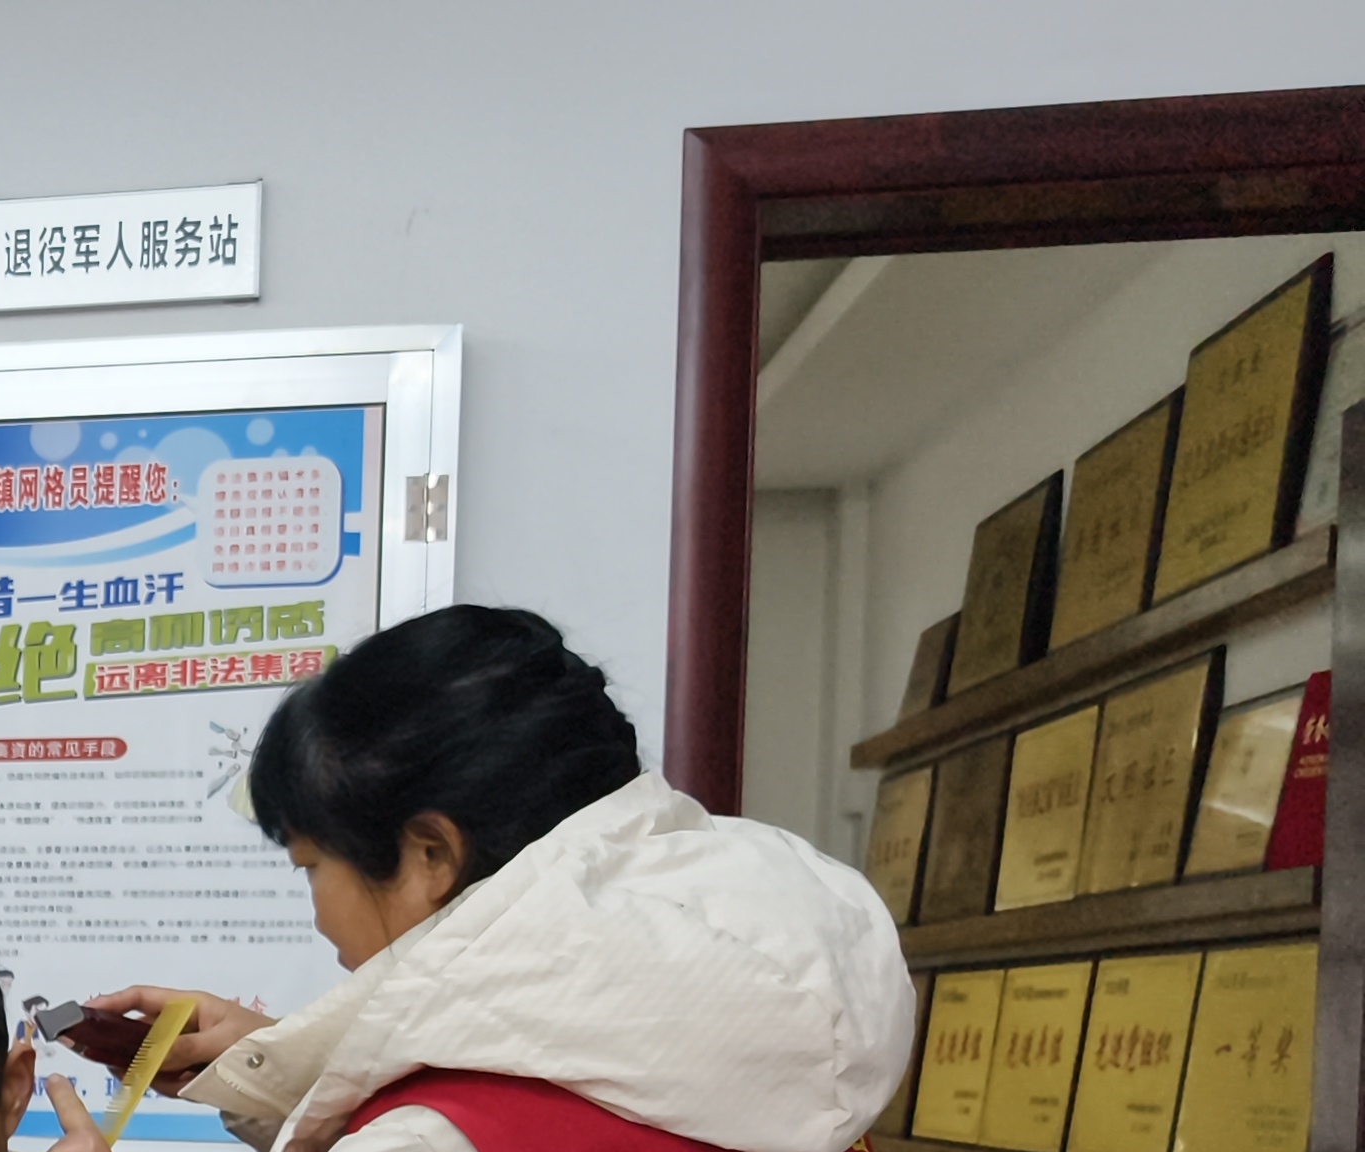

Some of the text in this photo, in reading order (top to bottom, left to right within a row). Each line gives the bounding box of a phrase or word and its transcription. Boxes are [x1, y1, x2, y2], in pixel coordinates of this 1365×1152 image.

[4, 213, 240, 277] 退役军人服务站
[90, 600, 325, 657] 高利诱惑
[95, 649, 323, 695] 远离非法集资
